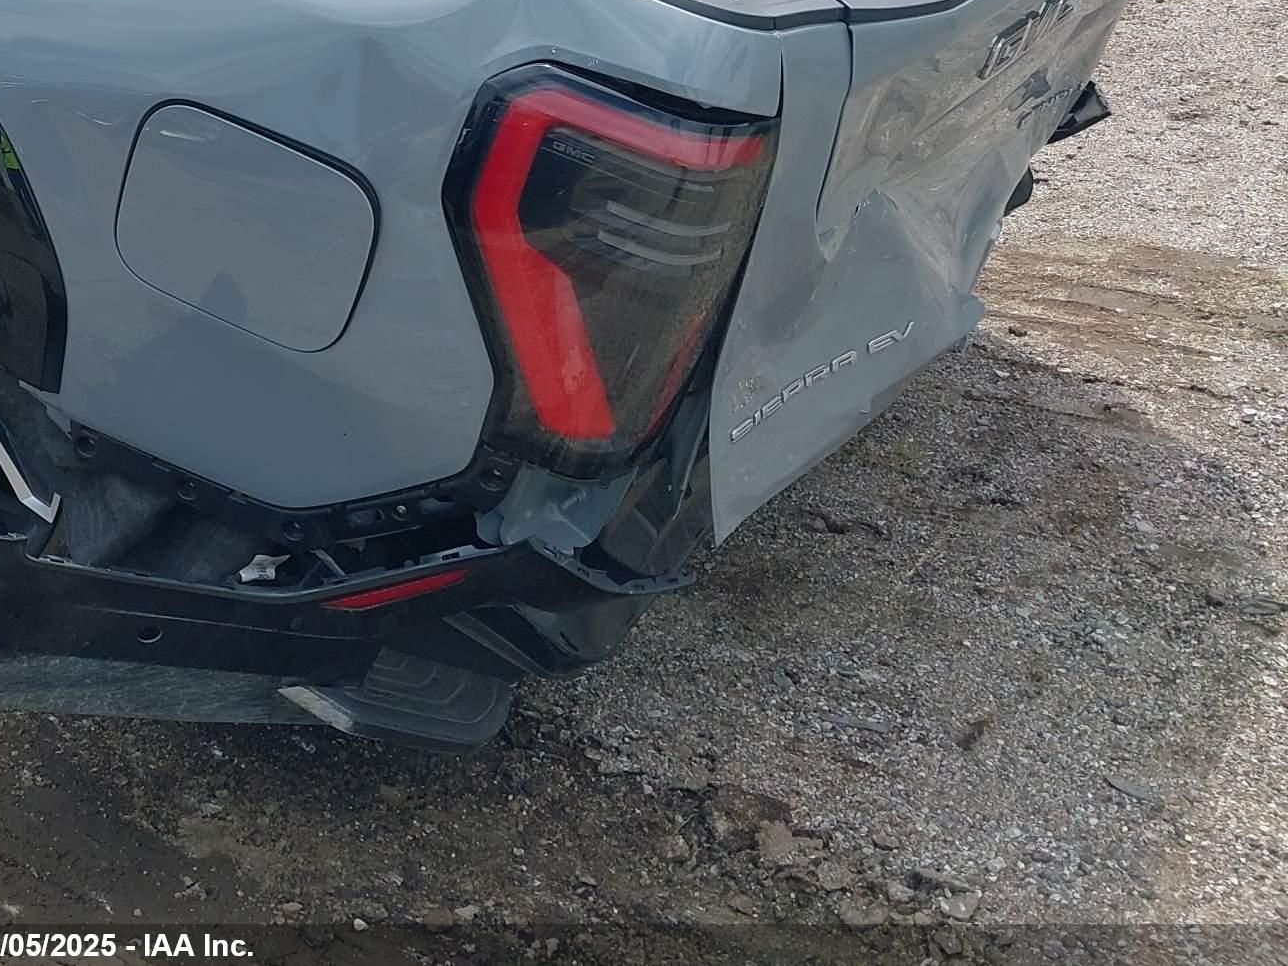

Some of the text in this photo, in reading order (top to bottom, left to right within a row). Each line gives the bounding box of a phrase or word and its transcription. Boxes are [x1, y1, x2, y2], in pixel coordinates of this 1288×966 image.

[552, 140, 595, 164] GMC
[730, 321, 914, 443] SIERRA EV
